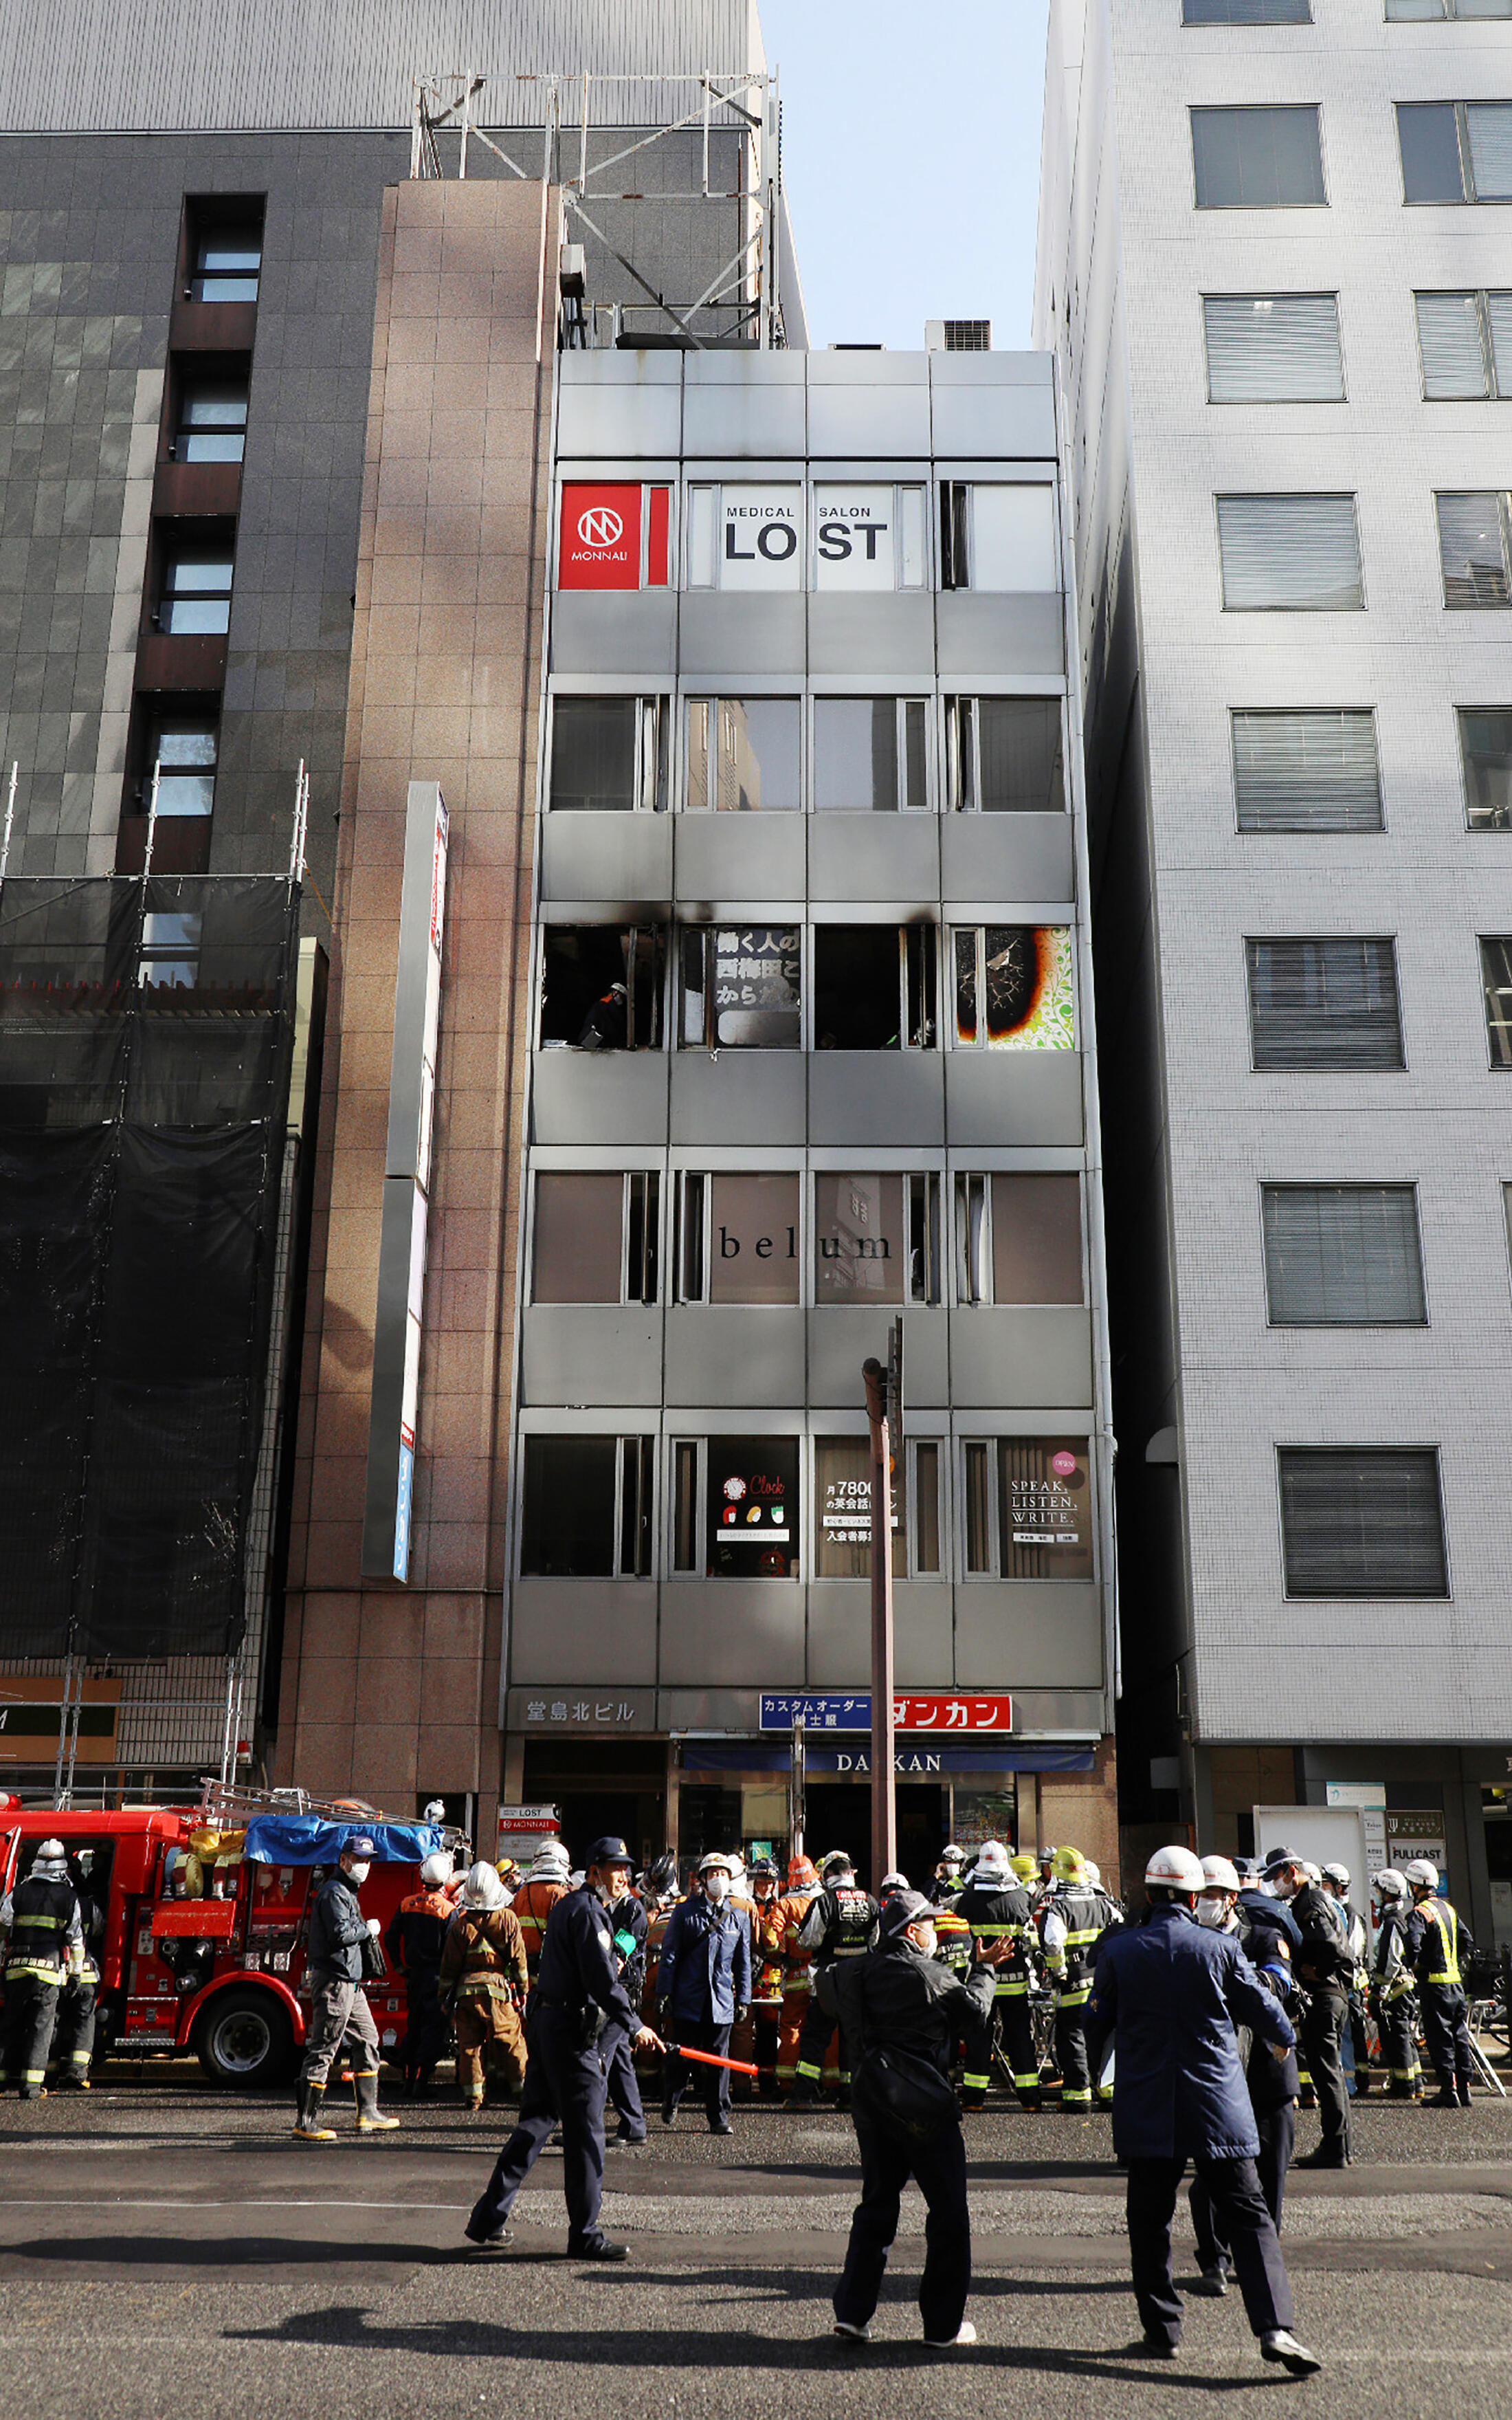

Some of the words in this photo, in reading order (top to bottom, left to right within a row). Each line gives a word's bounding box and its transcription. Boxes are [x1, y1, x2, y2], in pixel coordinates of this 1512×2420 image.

[727, 507, 794, 517] MEDICAL
[819, 507, 870, 517] SALON
[726, 522, 887, 560] LOST
[572, 551, 627, 560] MONNALI
[718, 1226, 891, 1258] belum
[750, 1475, 785, 1495] Clock
[1012, 1497, 1078, 1508] LISTEN,
[1012, 1512, 1074, 1523] WRITE.
[527, 1702, 634, 1721] 堂島北ビル
[764, 1700, 868, 1713] カスタムオーダー
[893, 1700, 998, 1727] ダンカン
[836, 1754, 941, 1772] DAKAN
[519, 1809, 542, 1817] LOST
[1392, 1848, 1441, 1860] FULLCAST
